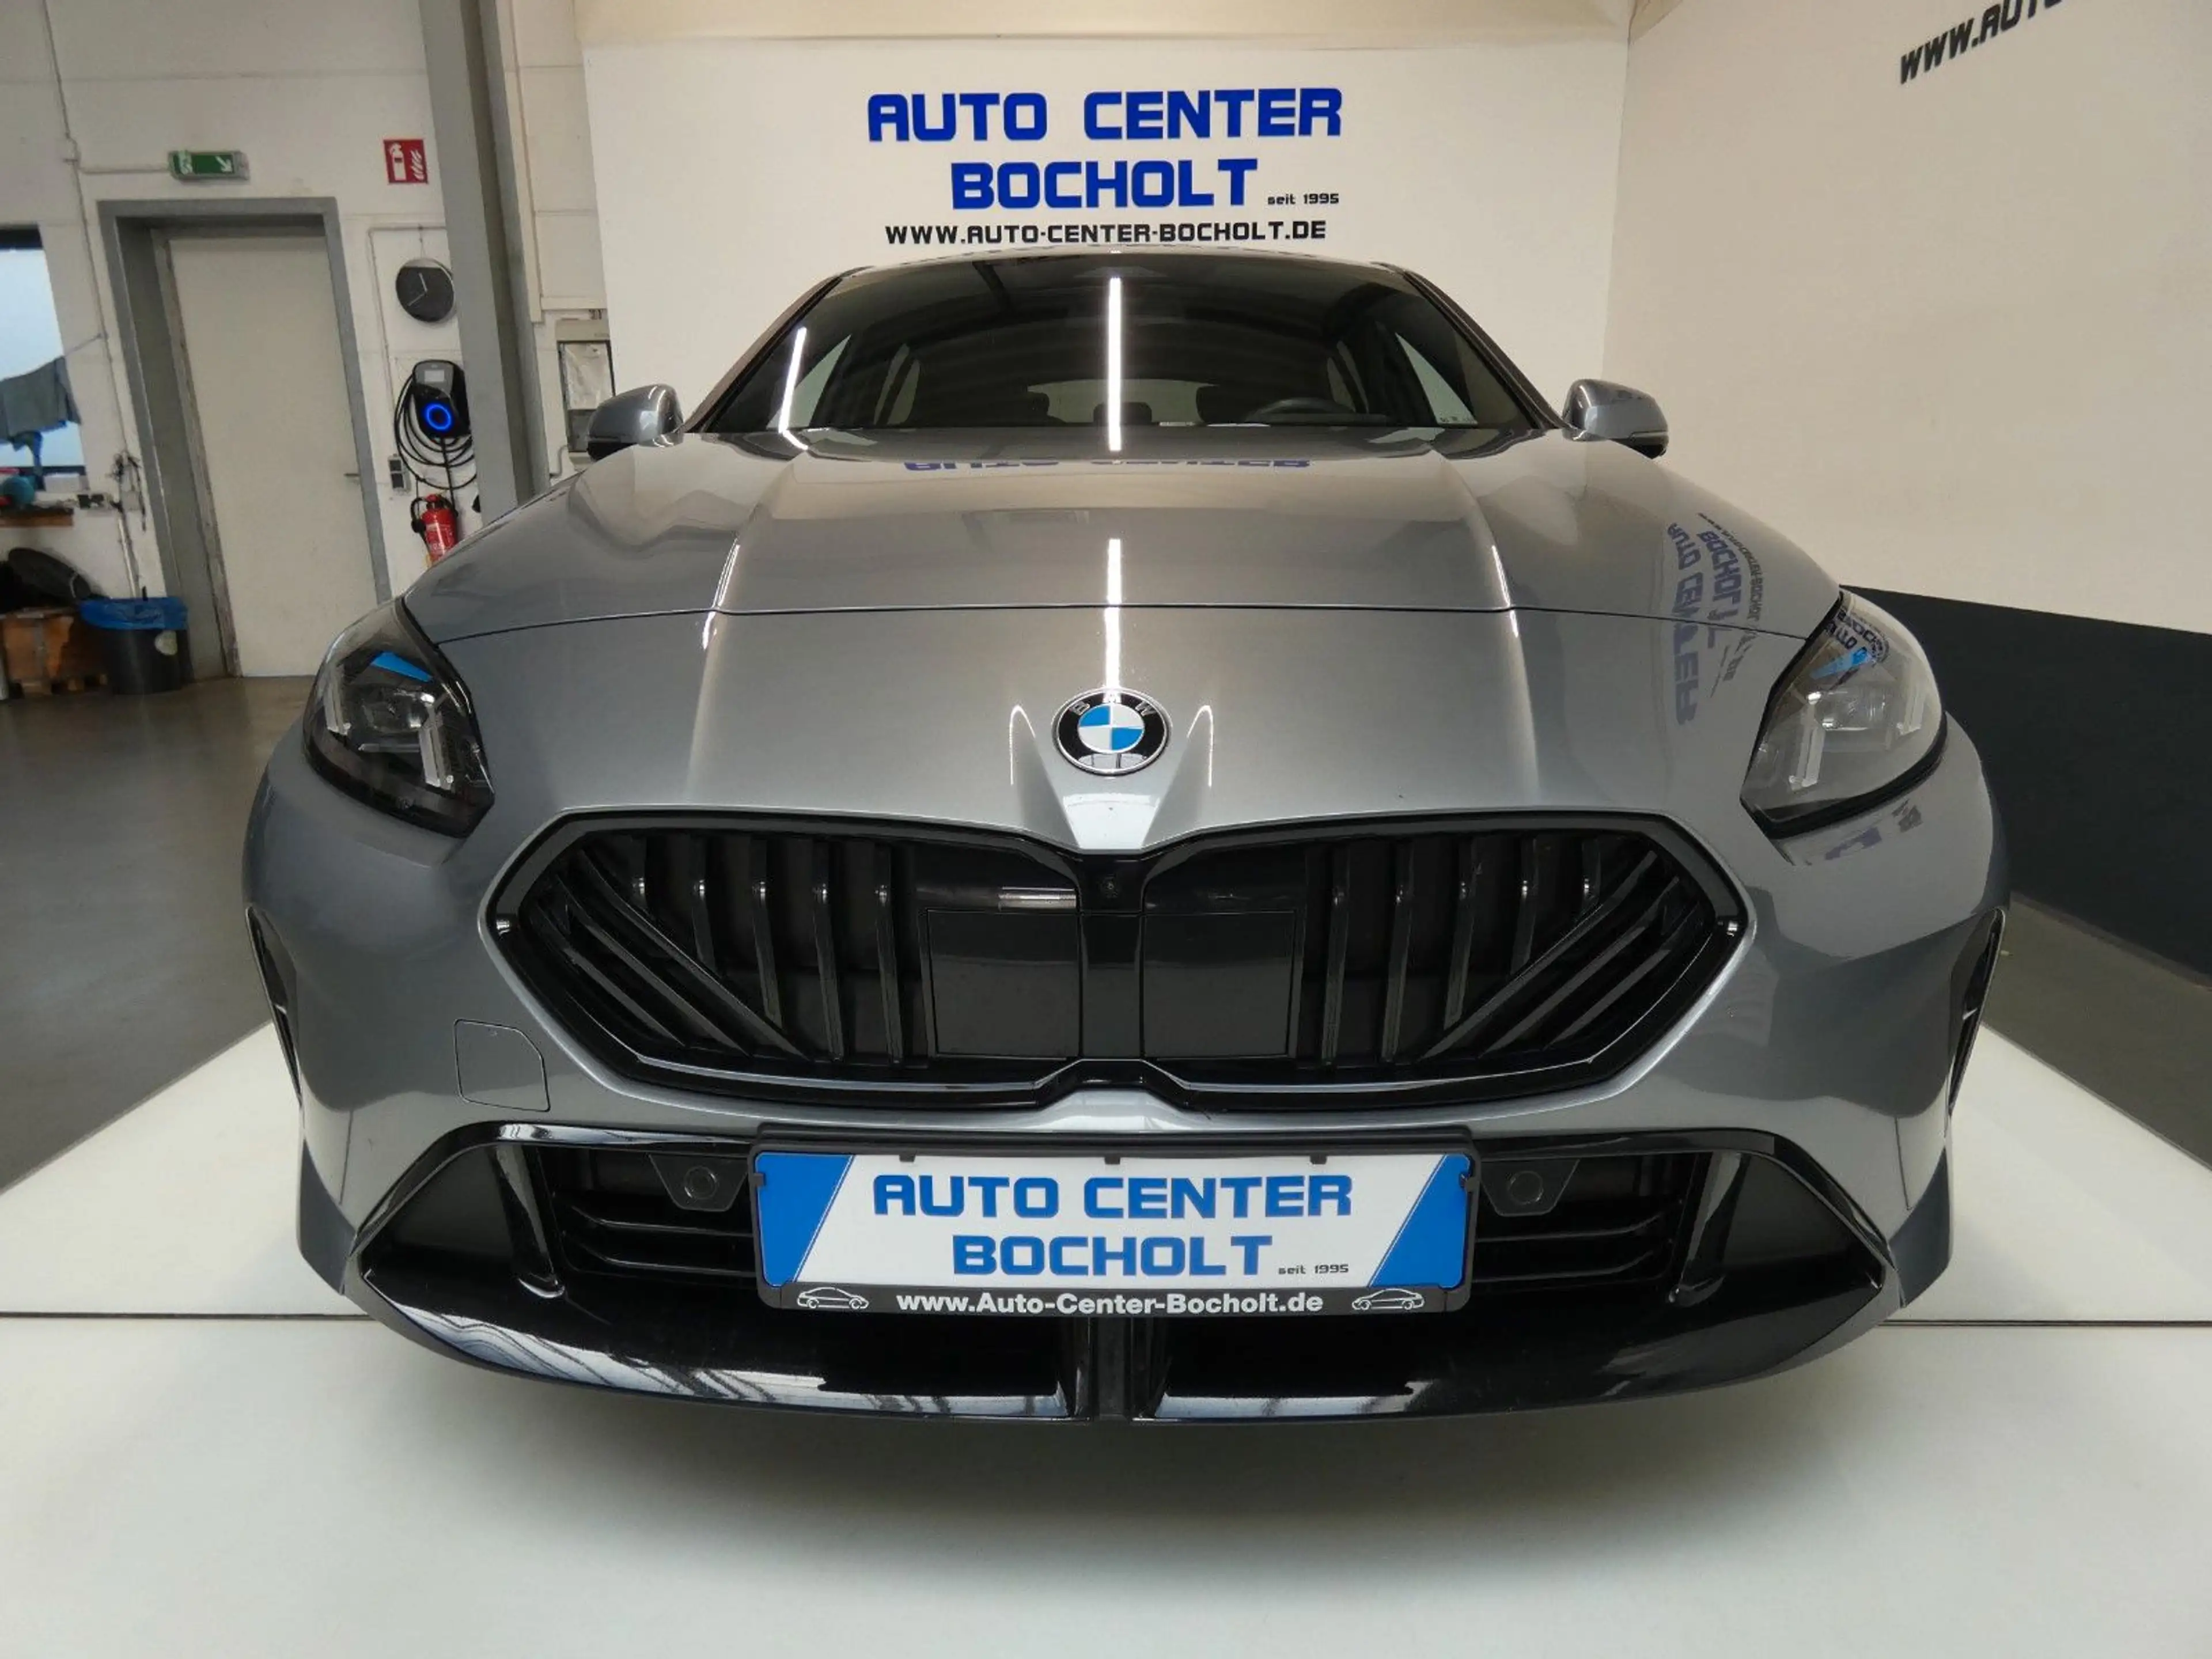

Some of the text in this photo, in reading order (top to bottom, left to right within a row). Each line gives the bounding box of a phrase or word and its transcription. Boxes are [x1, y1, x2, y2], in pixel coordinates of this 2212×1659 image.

[1901, 0, 2062, 84] WWW.AUT
[868, 88, 1342, 142] AUTO CENTER
[951, 158, 1339, 210] BOCHOLT seit 1995
[885, 219, 1327, 245] WWW.AUTO-CENTER-BOCHOLT.DE
[873, 1174, 1352, 1219] AUTO CENTER
[952, 1234, 1349, 1277] BOCHOLT seit 1995
[896, 1290, 1324, 1316] www.Auto-Center-Bocholt.de
